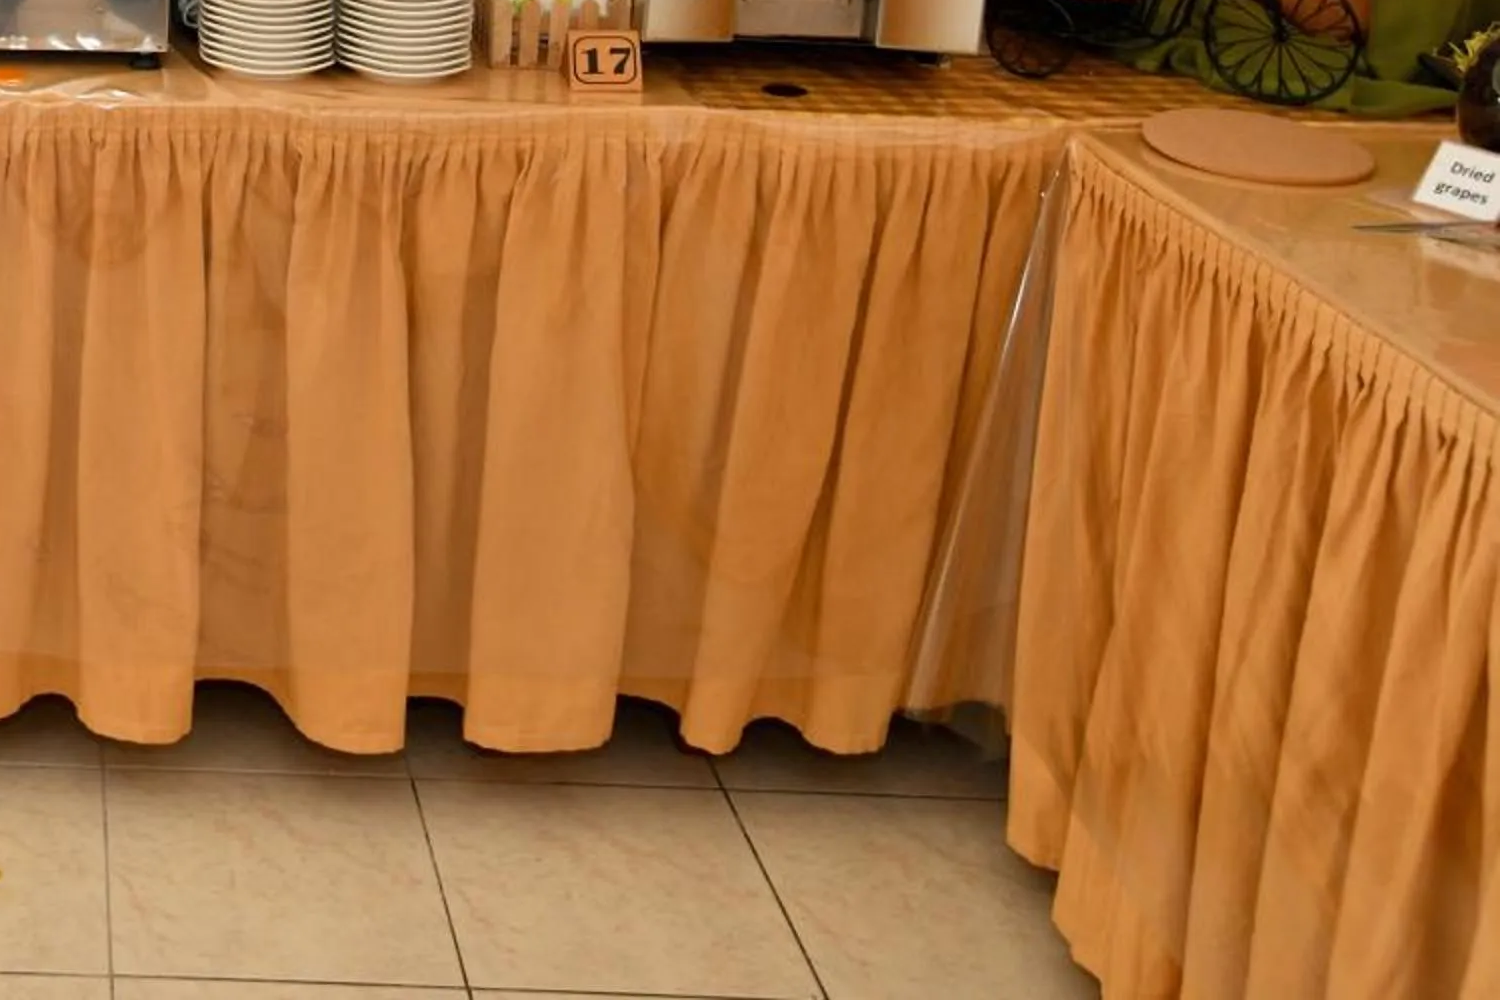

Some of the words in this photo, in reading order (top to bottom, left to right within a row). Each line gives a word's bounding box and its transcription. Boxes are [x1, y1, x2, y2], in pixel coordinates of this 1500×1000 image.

[580, 46, 632, 75] 17
[1450, 160, 1496, 184] Dried
[1432, 182, 1489, 206] grapes
